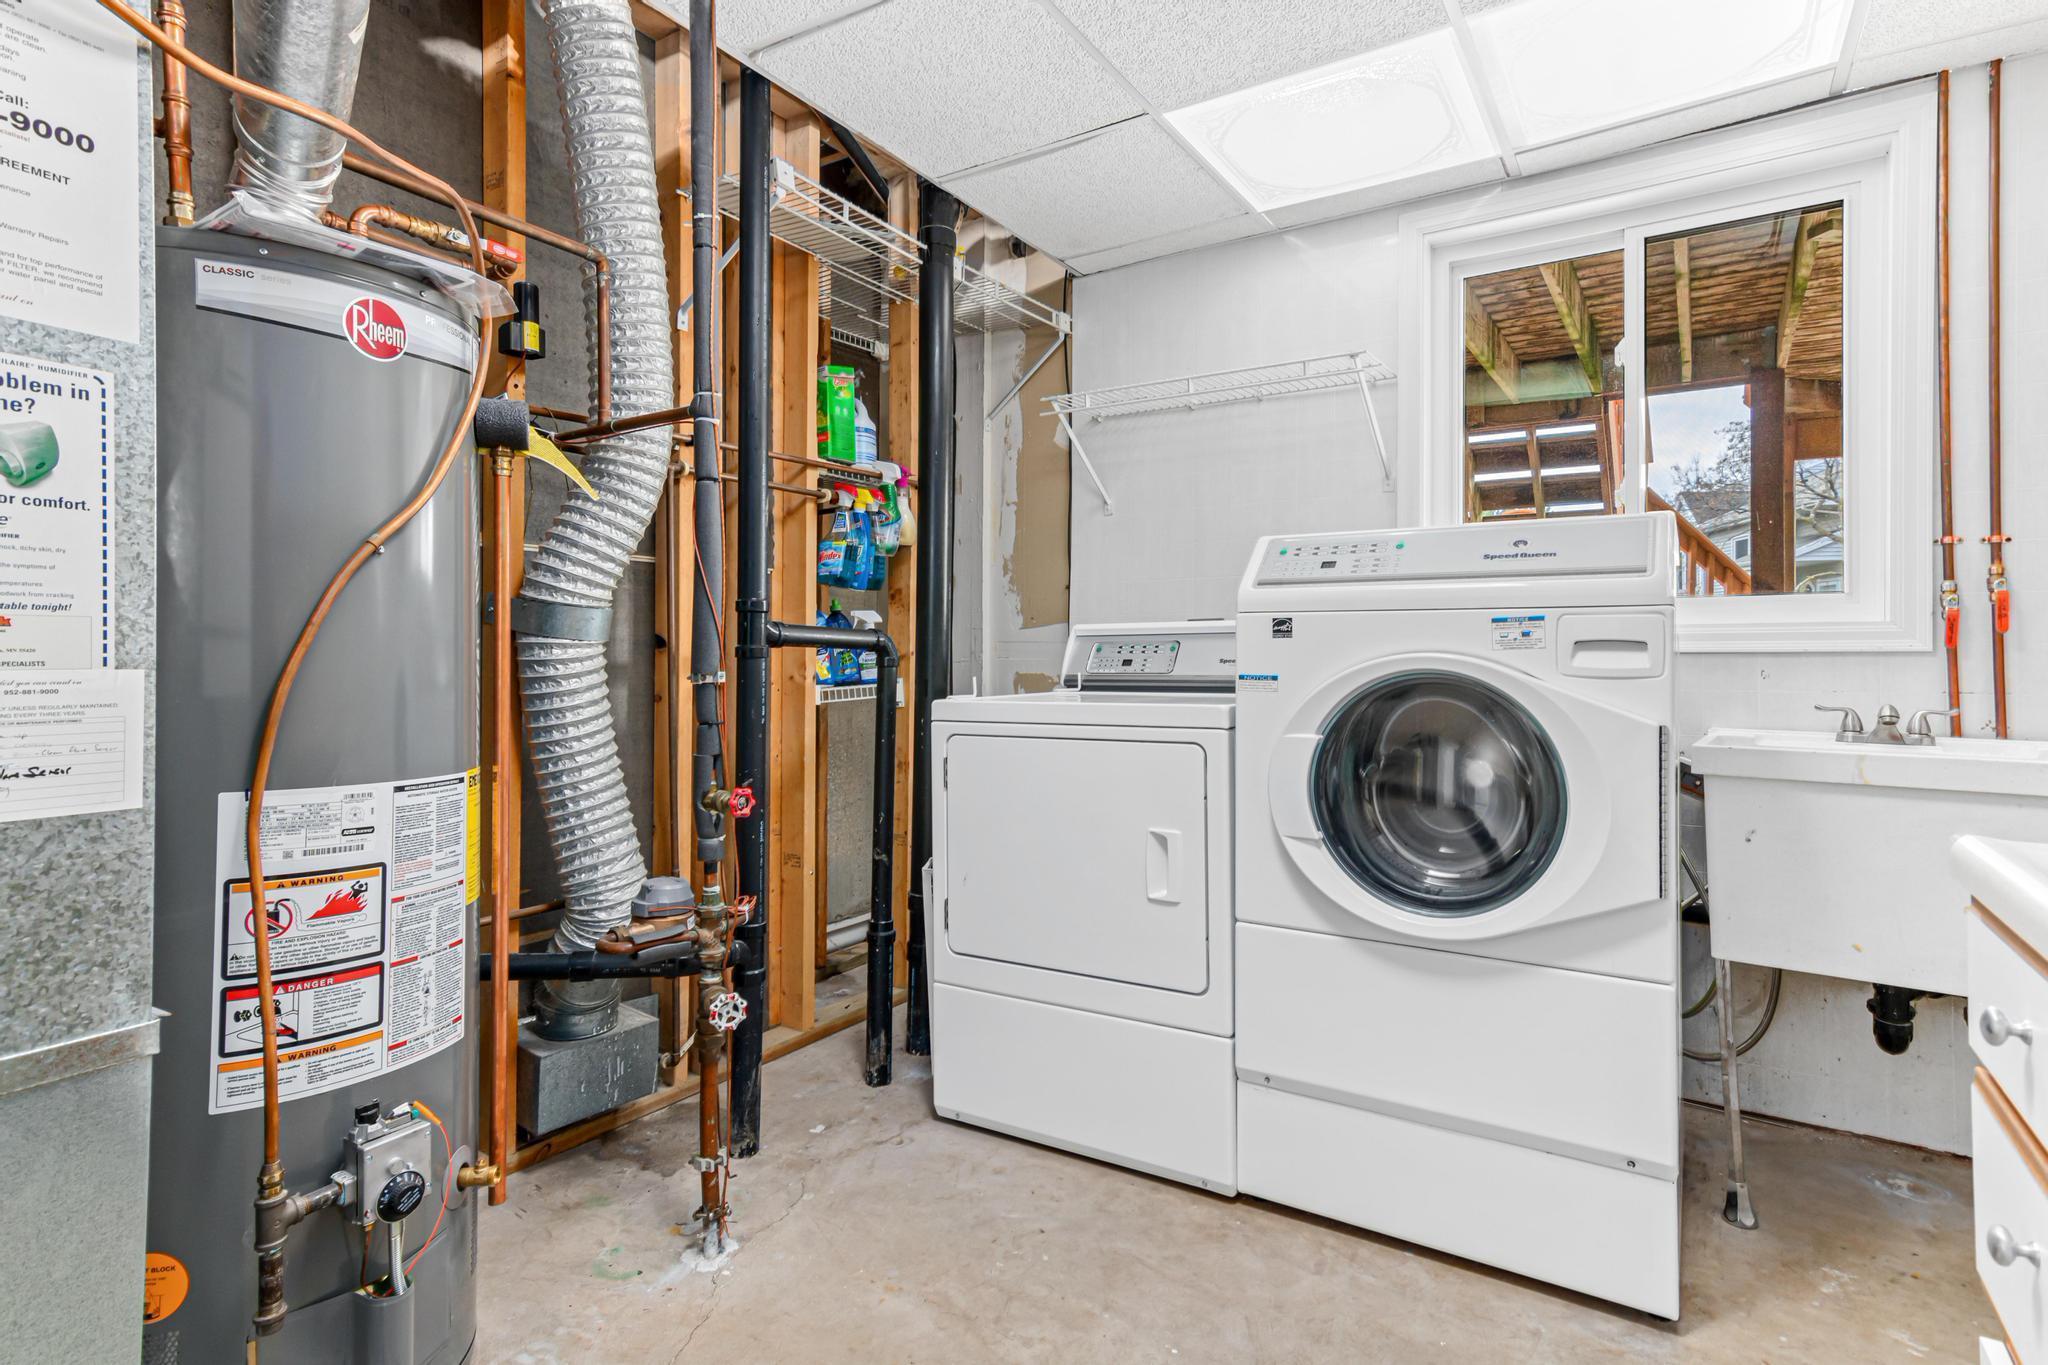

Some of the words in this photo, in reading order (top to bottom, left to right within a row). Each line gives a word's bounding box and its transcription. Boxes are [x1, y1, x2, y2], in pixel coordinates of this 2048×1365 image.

[6, 25, 39, 43] operate
[38, 231, 69, 246] Repairs
[17, 254, 28, 262] for
[30, 257, 43, 267] top
[44, 261, 94, 279] performance
[58, 273, 103, 289] recommend
[202, 264, 255, 279] CLASSIC
[260, 273, 292, 286] series
[8, 269, 31, 279] water
[33, 275, 56, 285] panel
[59, 281, 74, 290] and
[76, 285, 103, 297] special
[352, 298, 405, 349] Rheem
[37, 364, 88, 379] HUMIDIFIER
[71, 383, 90, 401] in
[22, 496, 91, 512] comfort.
[1483, 553, 1519, 561] Speed
[1520, 551, 1557, 559] Queen
[13, 562, 47, 570] symptoms
[31, 603, 72, 613] tonight!
[0, 660, 46, 668] PECIALISTS
[3, 688, 59, 696] 952-881-9000
[38, 703, 78, 711] REGULARLY
[13, 711, 37, 719] EVERY
[291, 875, 344, 887] WARNING
[287, 978, 335, 992] DANGER
[288, 1045, 337, 1062] WARNING
[151, 1265, 177, 1273] BLOCK
